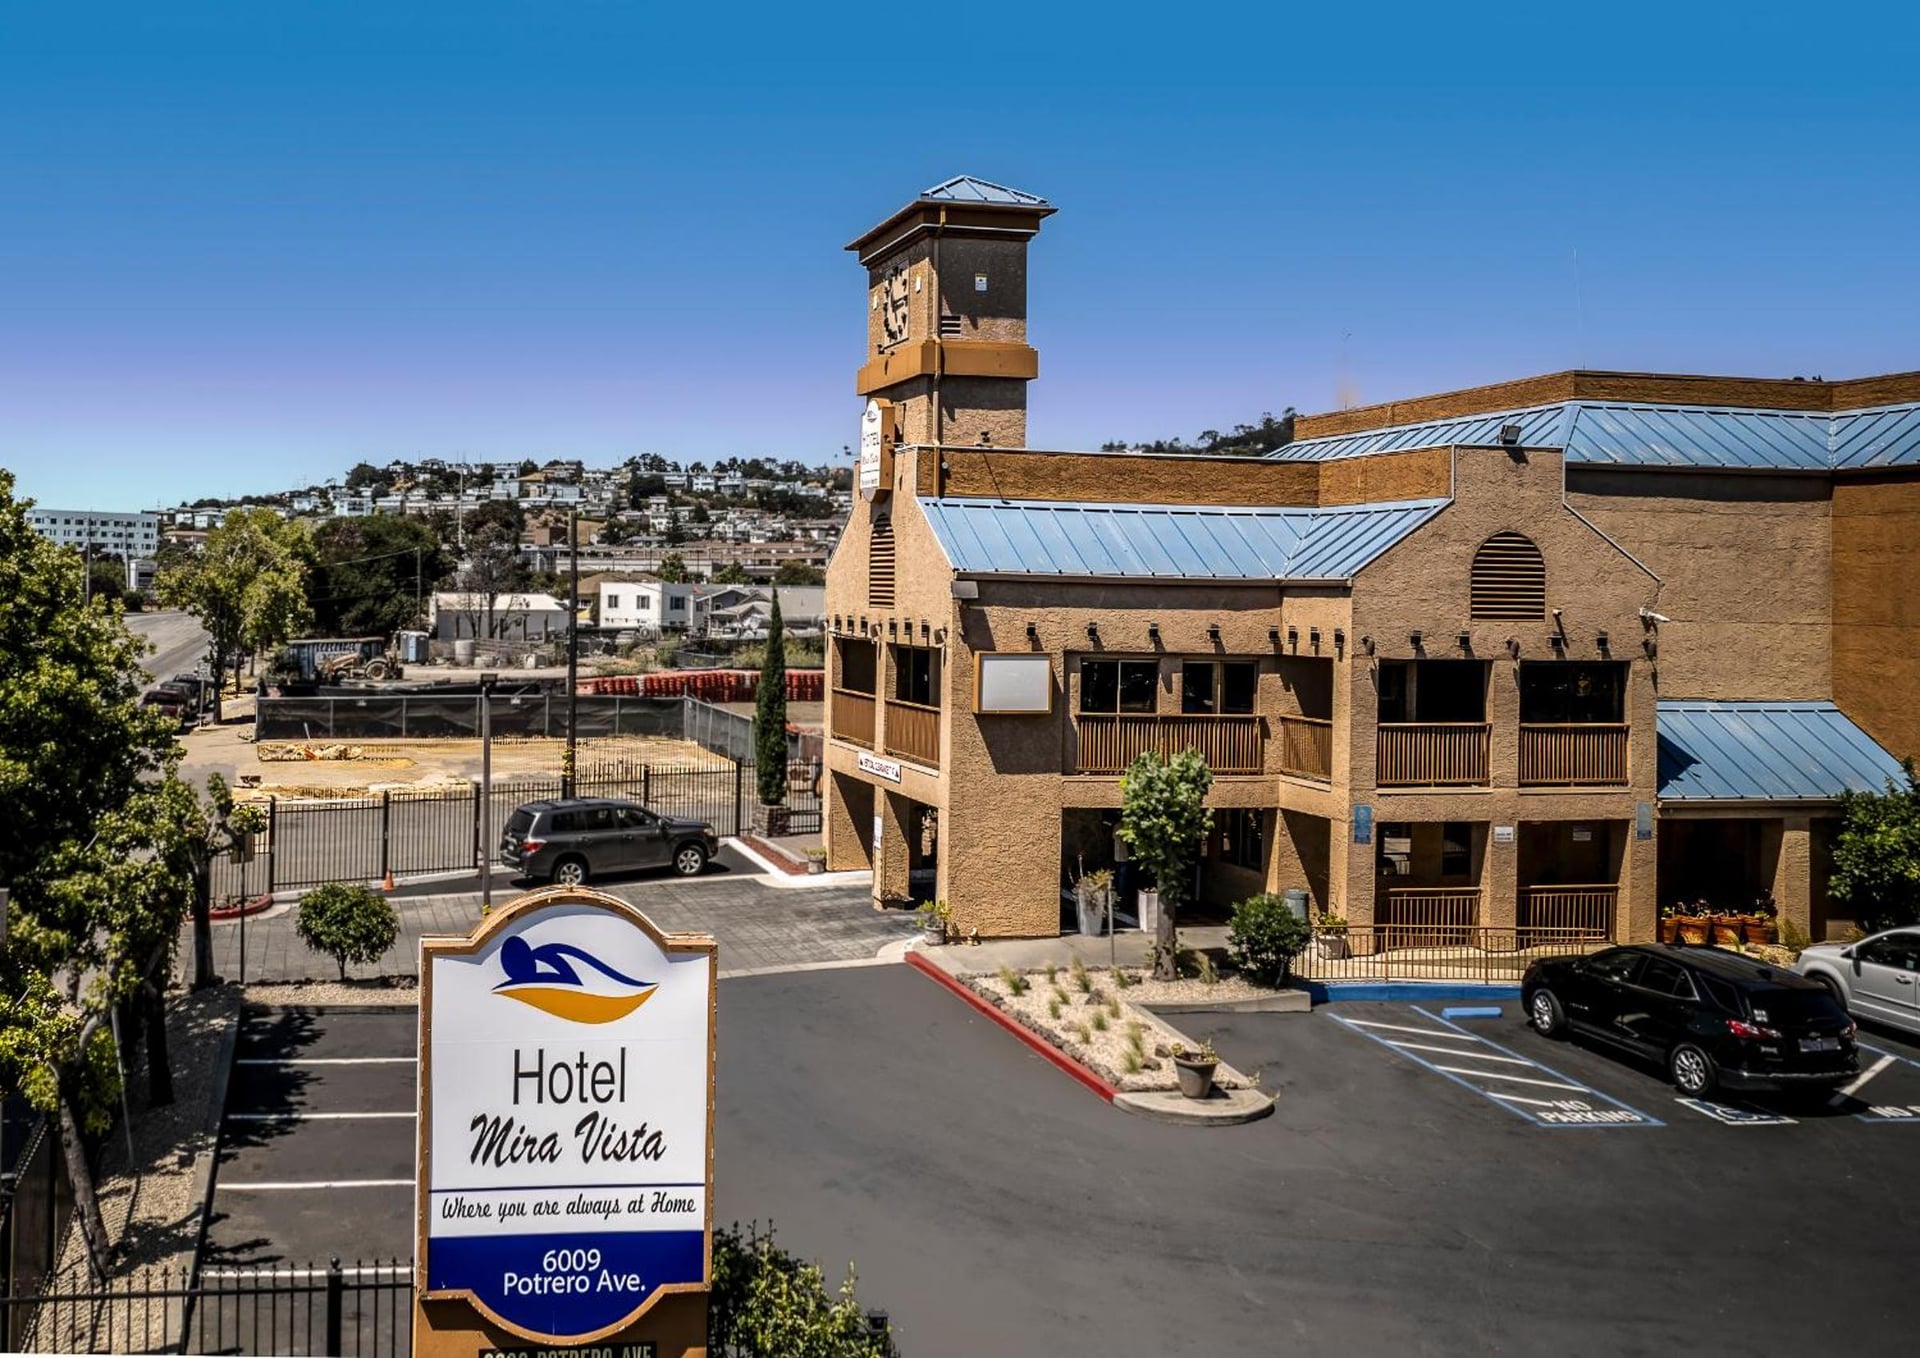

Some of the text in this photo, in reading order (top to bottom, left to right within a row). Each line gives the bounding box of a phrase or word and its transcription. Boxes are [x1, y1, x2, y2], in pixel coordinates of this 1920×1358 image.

[513, 1047, 626, 1106] Hotel
[1536, 1110, 1642, 1123] PARKING
[1551, 1100, 1592, 1111] NO
[1867, 1105, 1913, 1118] NO
[470, 1110, 667, 1168] Mira Vista
[442, 1191, 697, 1223] Where you are always at Home
[543, 1249, 601, 1273] 6009
[504, 1269, 646, 1296] Potrero Ave.
[622, 1345, 651, 1358] AVE
